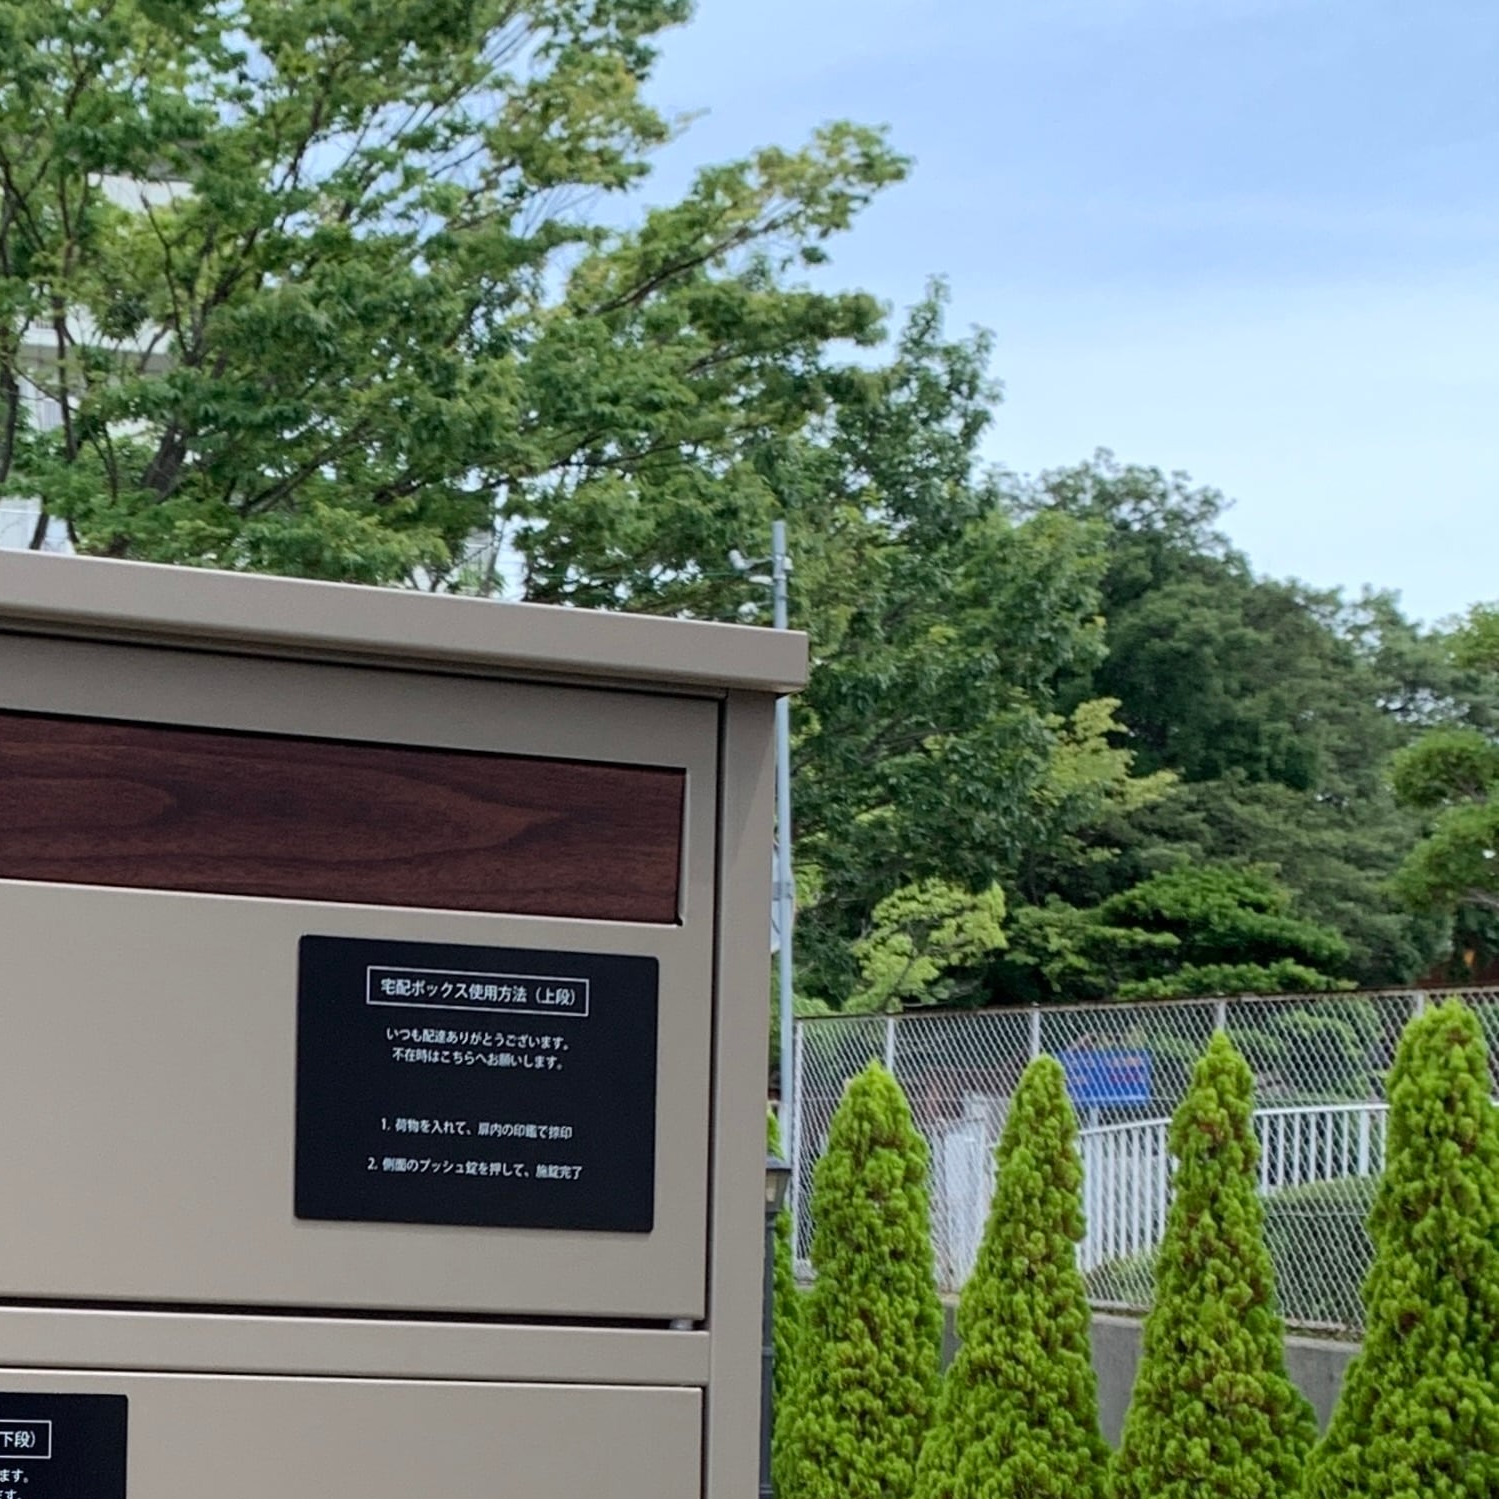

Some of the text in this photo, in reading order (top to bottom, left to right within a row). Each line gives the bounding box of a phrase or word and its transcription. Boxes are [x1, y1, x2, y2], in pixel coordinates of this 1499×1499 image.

[386, 1027, 569, 1051] いつも配達ありがとうございます。
[392, 1047, 563, 1070] 不在時はこちらへお願いします。
